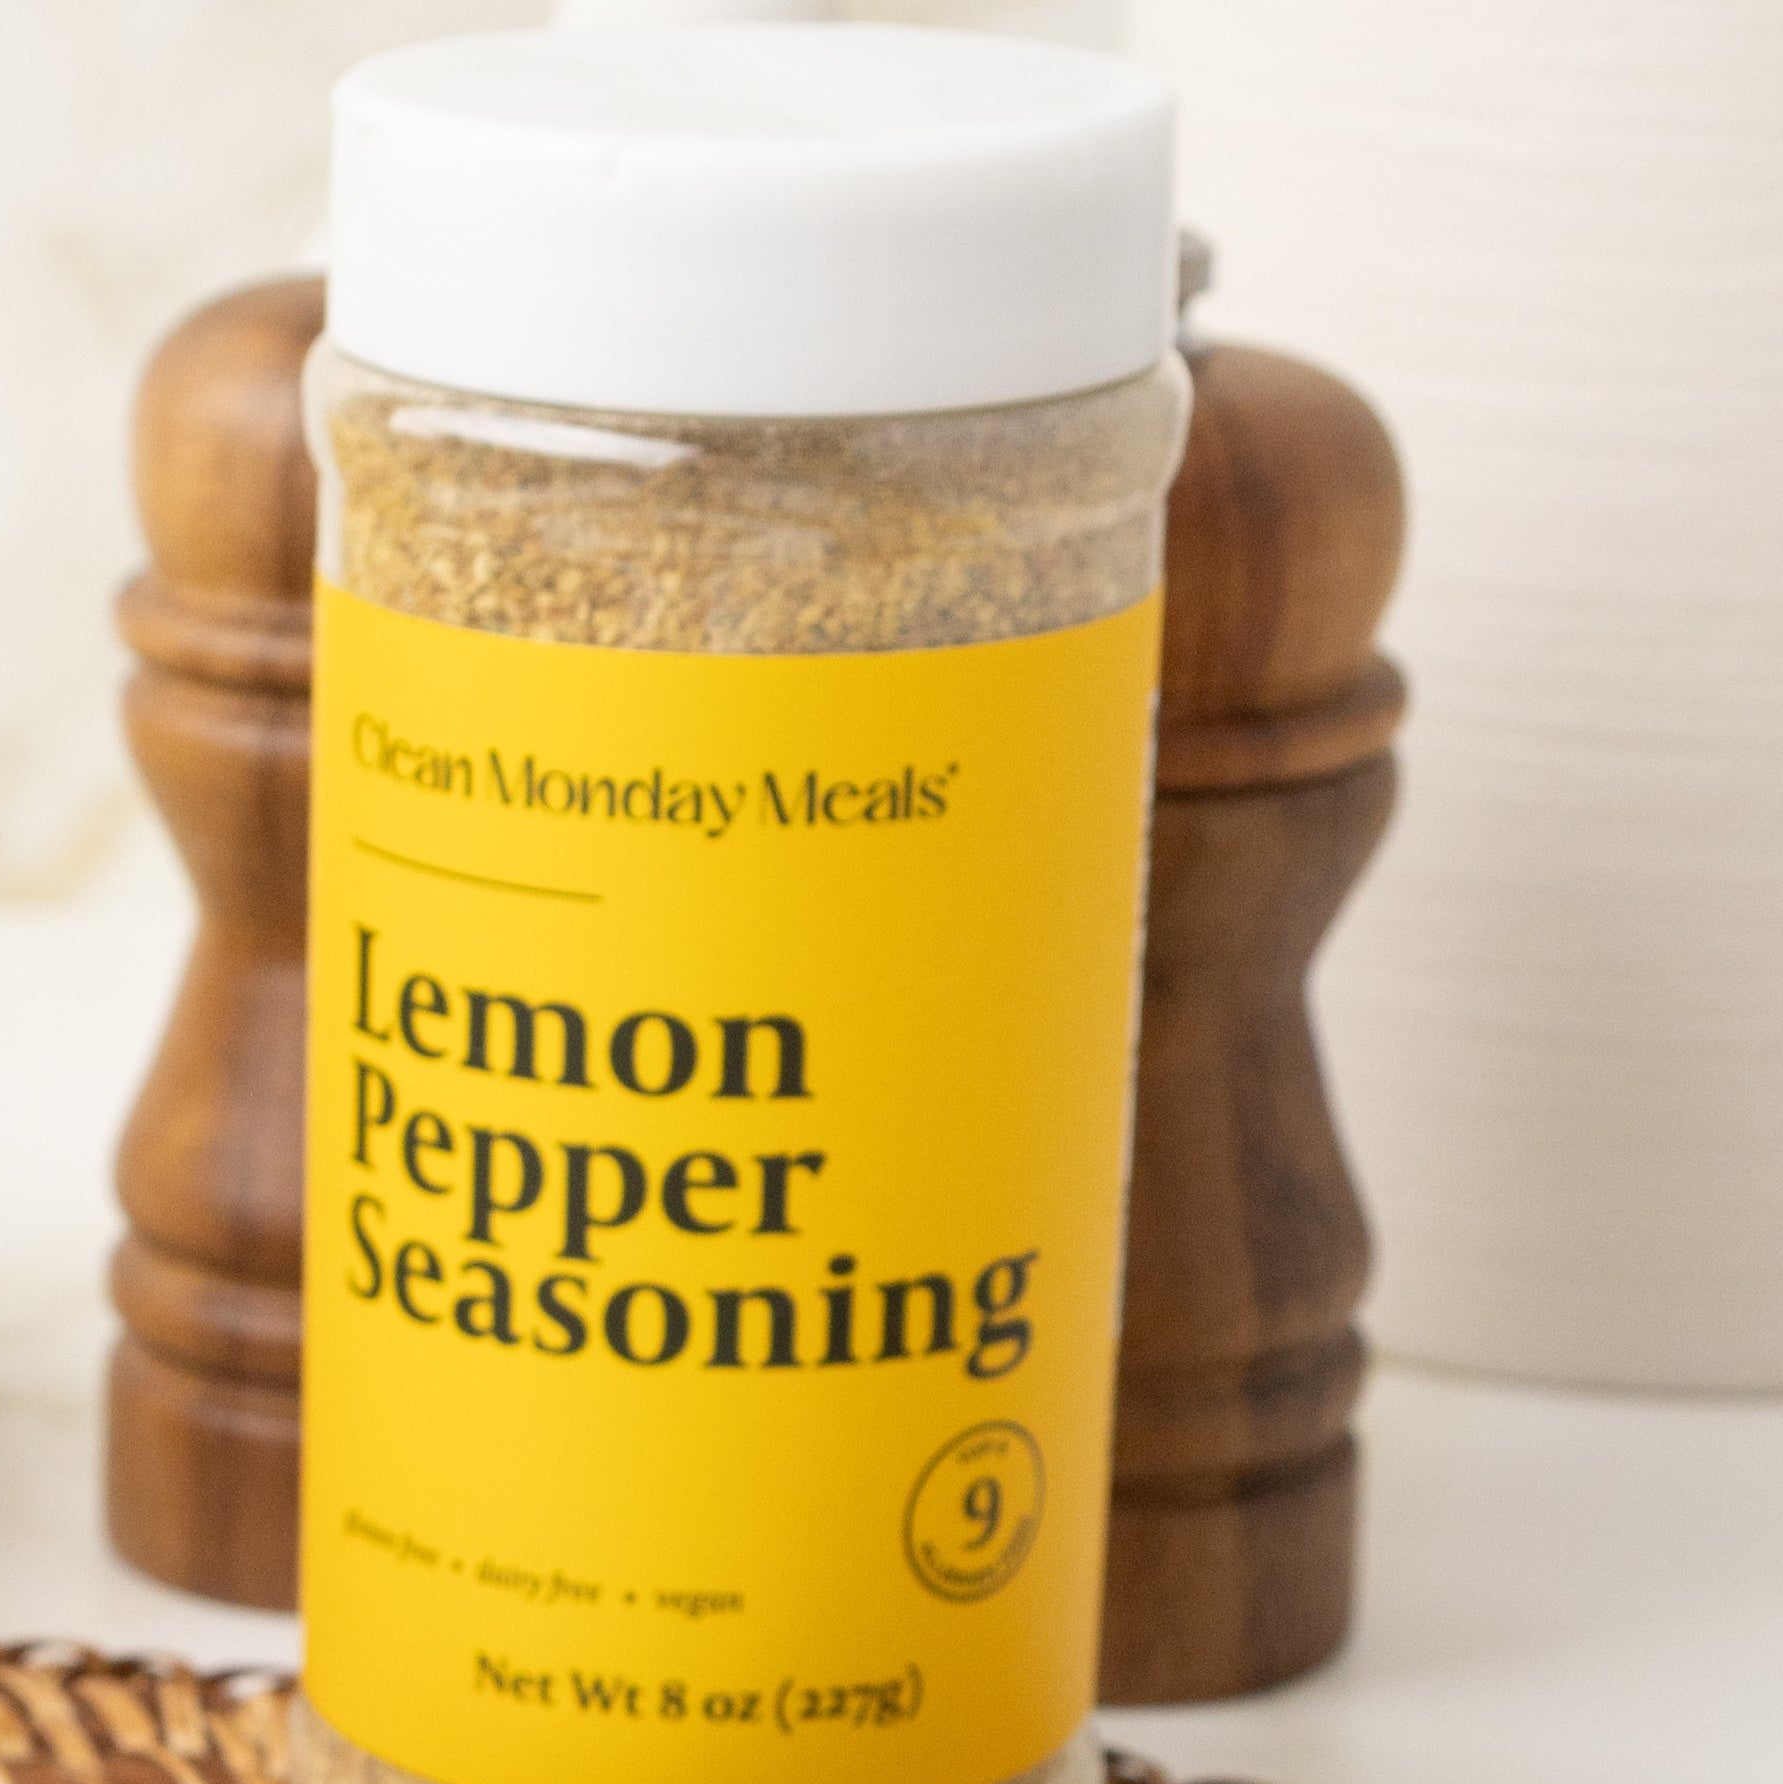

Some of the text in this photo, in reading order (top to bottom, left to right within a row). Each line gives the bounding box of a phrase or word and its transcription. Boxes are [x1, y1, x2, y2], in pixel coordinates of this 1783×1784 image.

[351, 711, 475, 800] Clean
[484, 747, 748, 838] Monday
[352, 921, 816, 1101] Lemon
[353, 1055, 828, 1263] Pepper
[347, 1193, 1040, 1382] Seasoning
[962, 1472, 1003, 1552] 9
[655, 1588, 746, 1621] vegan
[473, 1648, 926, 1736] Net Wt 8 oz (227g)
